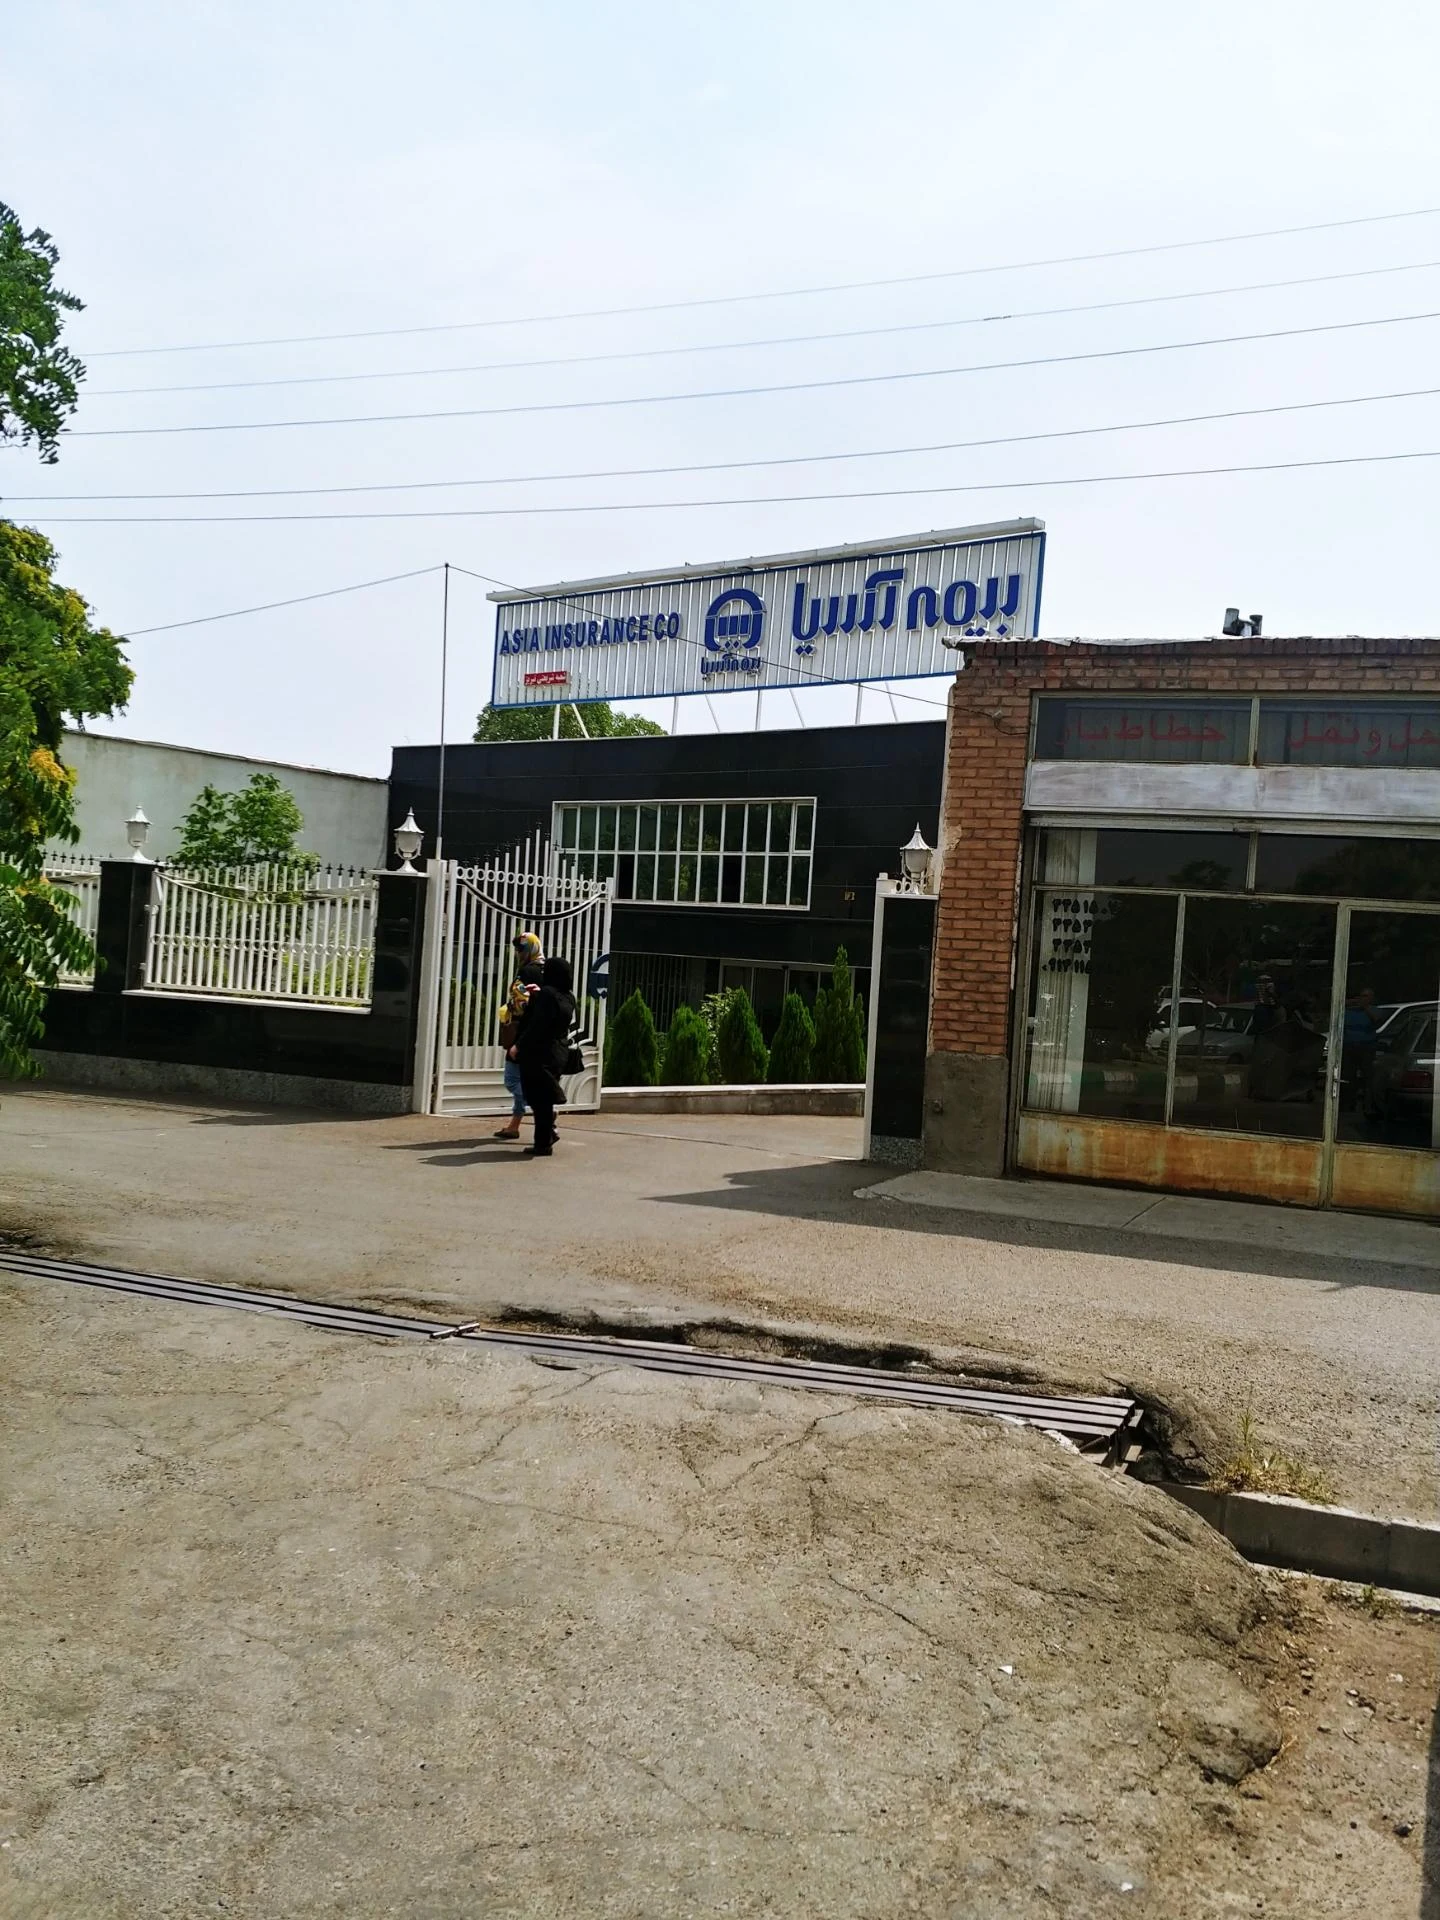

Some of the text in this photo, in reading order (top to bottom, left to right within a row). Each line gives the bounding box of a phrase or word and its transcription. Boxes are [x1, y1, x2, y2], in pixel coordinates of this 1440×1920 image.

[500, 611, 680, 656] ASIA INSURANCE CO
[792, 568, 1021, 656] بیمه آسیا
[1363, 728, 1381, 757] و
